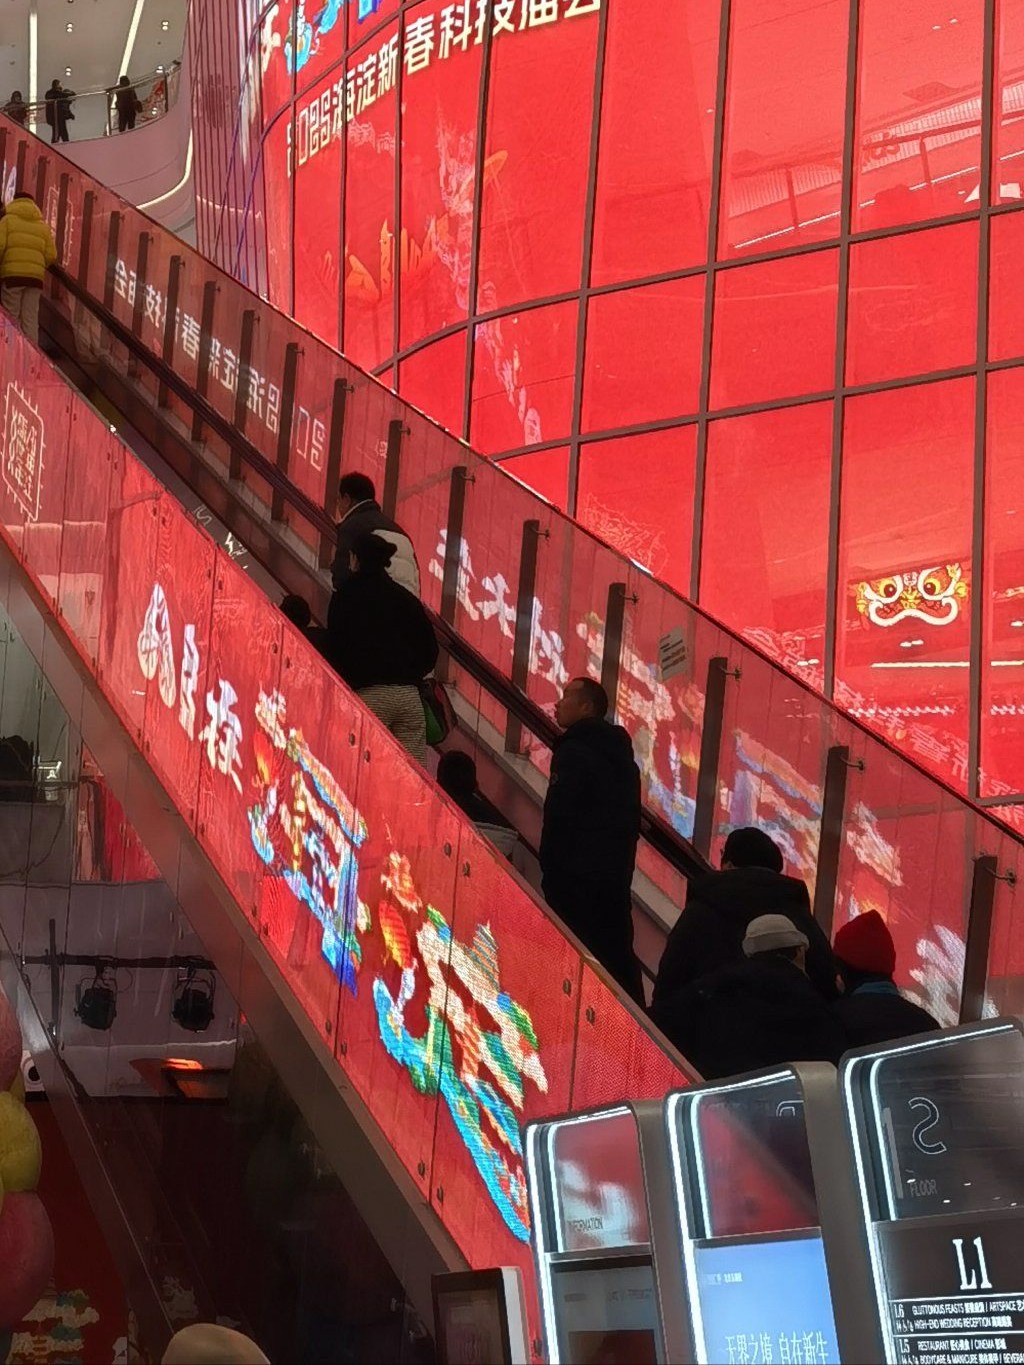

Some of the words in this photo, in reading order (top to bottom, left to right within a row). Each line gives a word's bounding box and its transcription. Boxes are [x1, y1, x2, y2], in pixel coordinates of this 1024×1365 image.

[952, 1236, 993, 1290] L1
[945, 1303, 964, 1314] FEASTS
[963, 1317, 992, 1328] RECEPTION
[778, 1330, 829, 1365] 自在新生
[917, 1340, 950, 1351] RESTAURANT
